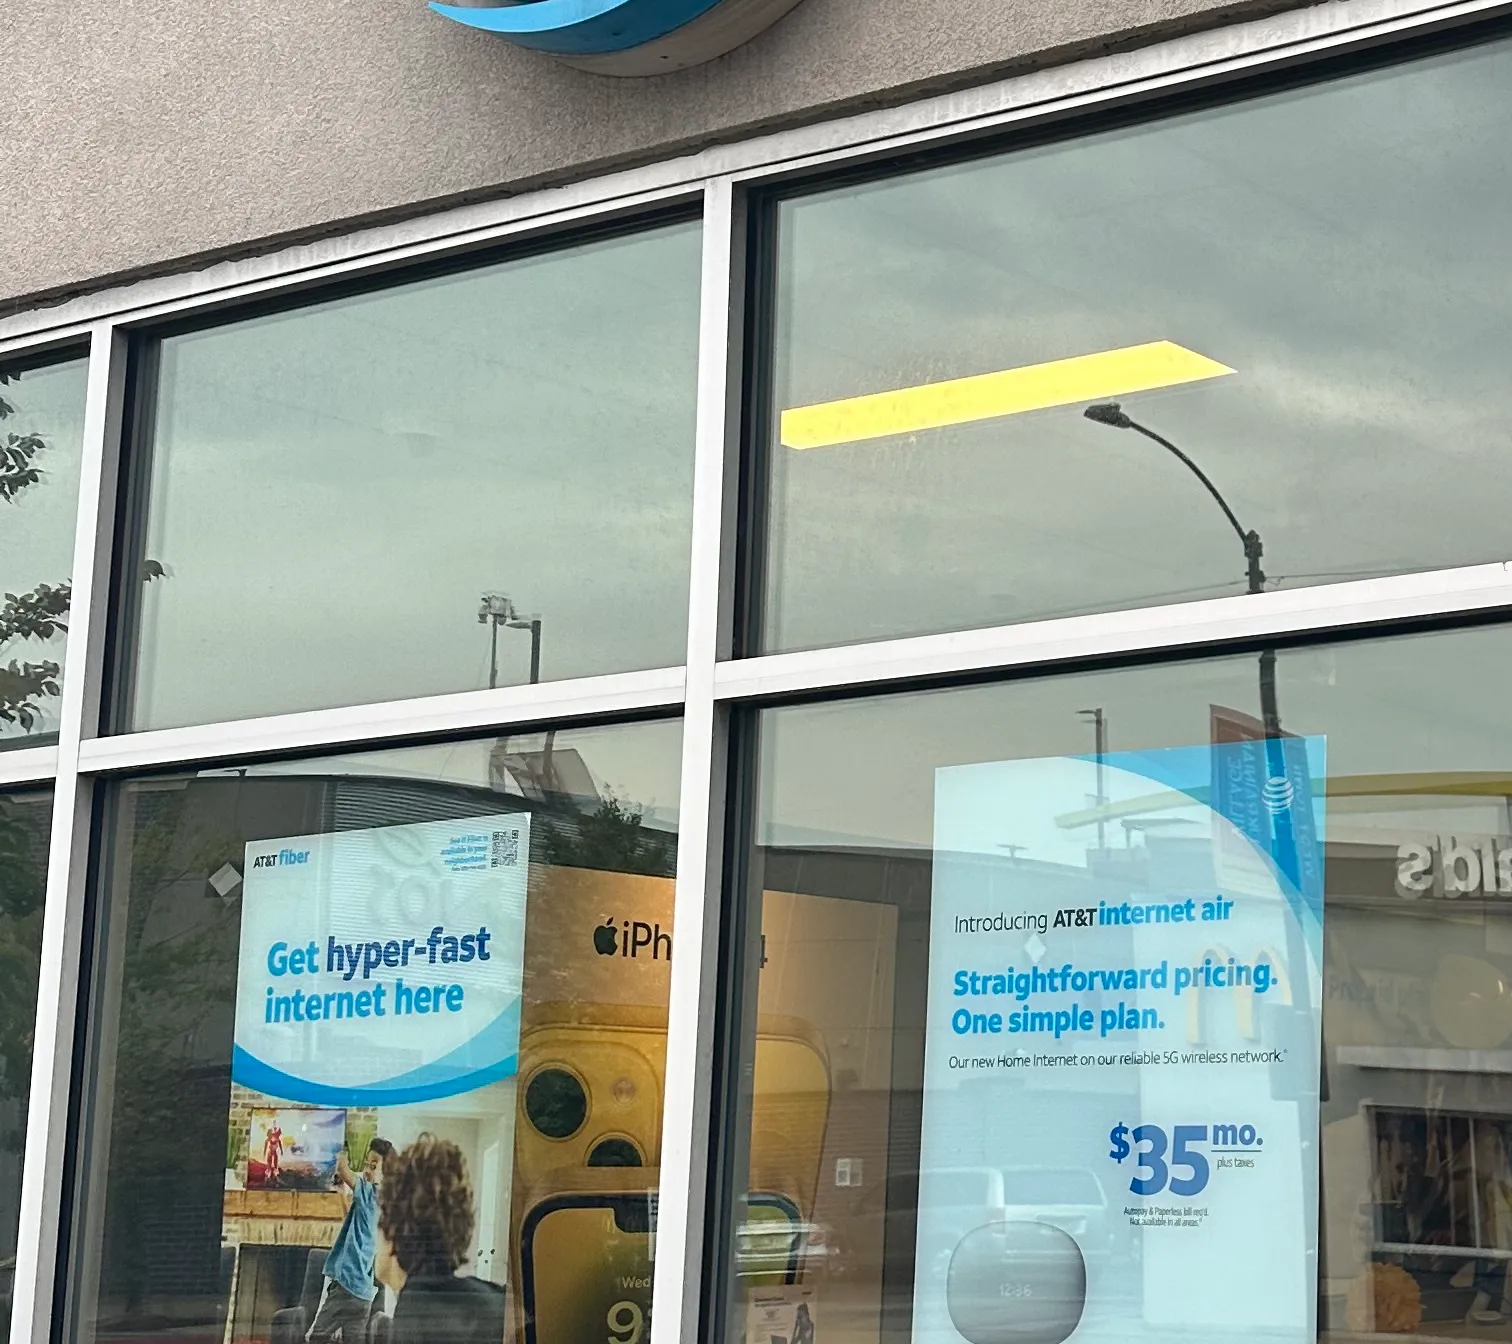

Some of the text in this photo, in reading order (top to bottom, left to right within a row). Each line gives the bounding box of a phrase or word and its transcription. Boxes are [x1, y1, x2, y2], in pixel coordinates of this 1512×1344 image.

[253, 849, 311, 869] AT&T fiber
[954, 894, 1235, 935] Introducing AT&T internet air
[267, 926, 491, 981] Get hyper-fast
[953, 956, 1278, 1000] Straightforward pricing.
[264, 977, 464, 1024] internet here
[951, 1002, 1166, 1040] One simple plan.
[949, 1056, 970, 1069] Our
[971, 1057, 995, 1068] new
[997, 1055, 1031, 1068] Home
[1033, 1053, 1079, 1067] Internet
[1080, 1056, 1096, 1066] on
[1097, 1054, 1118, 1066] our
[1119, 1050, 1161, 1065] reliable
[1163, 1050, 1179, 1065] 5G
[1181, 1048, 1229, 1064] wireless
[1109, 1121, 1264, 1196] $35 mo.
[1217, 1156, 1233, 1171] plus
